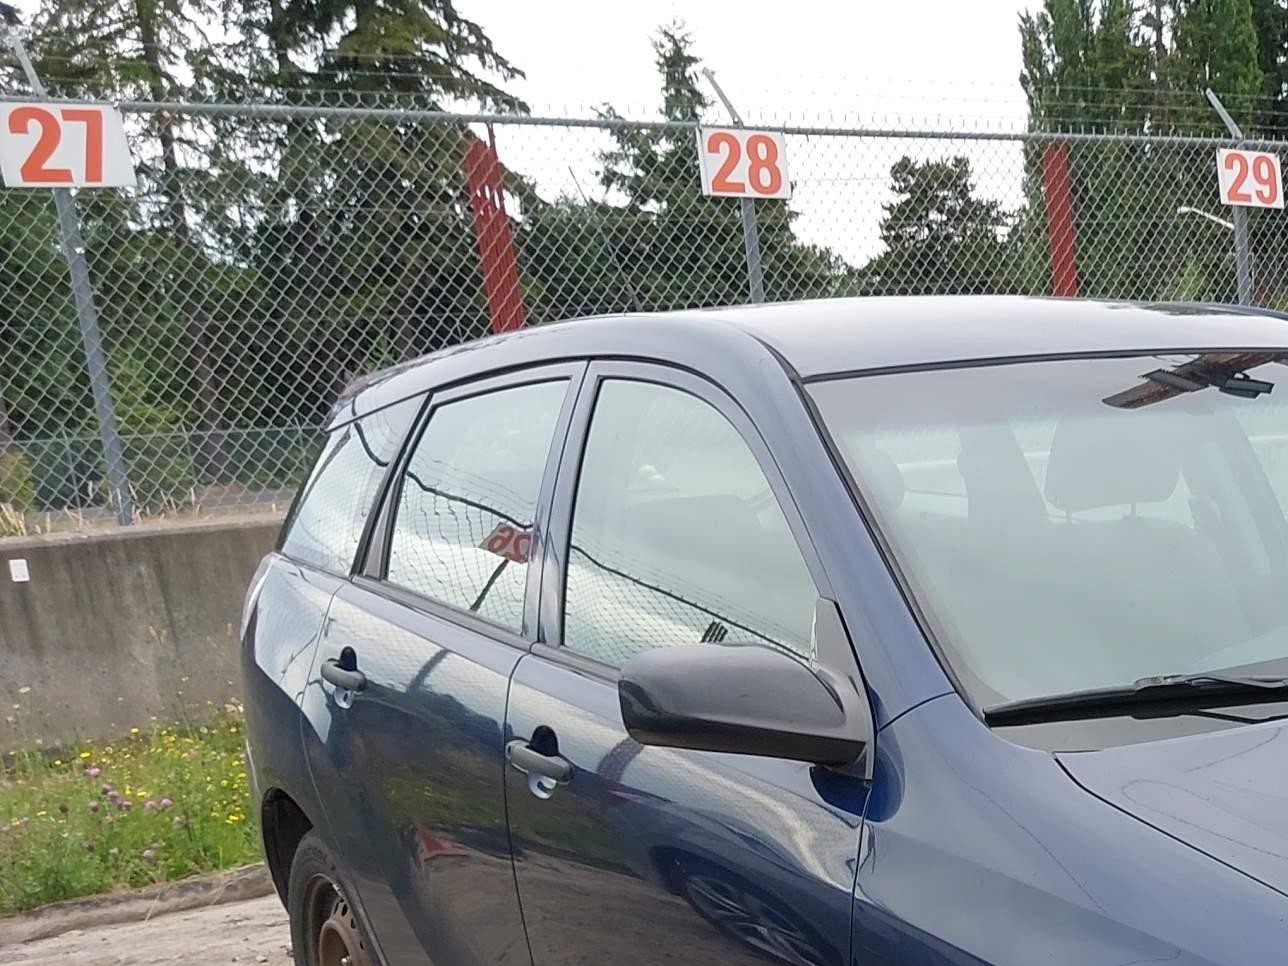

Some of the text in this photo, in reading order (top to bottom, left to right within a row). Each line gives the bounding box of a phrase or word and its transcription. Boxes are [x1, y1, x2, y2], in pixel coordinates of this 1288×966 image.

[8, 106, 103, 183] 27
[707, 131, 782, 195] 28
[1224, 152, 1278, 205] 29
